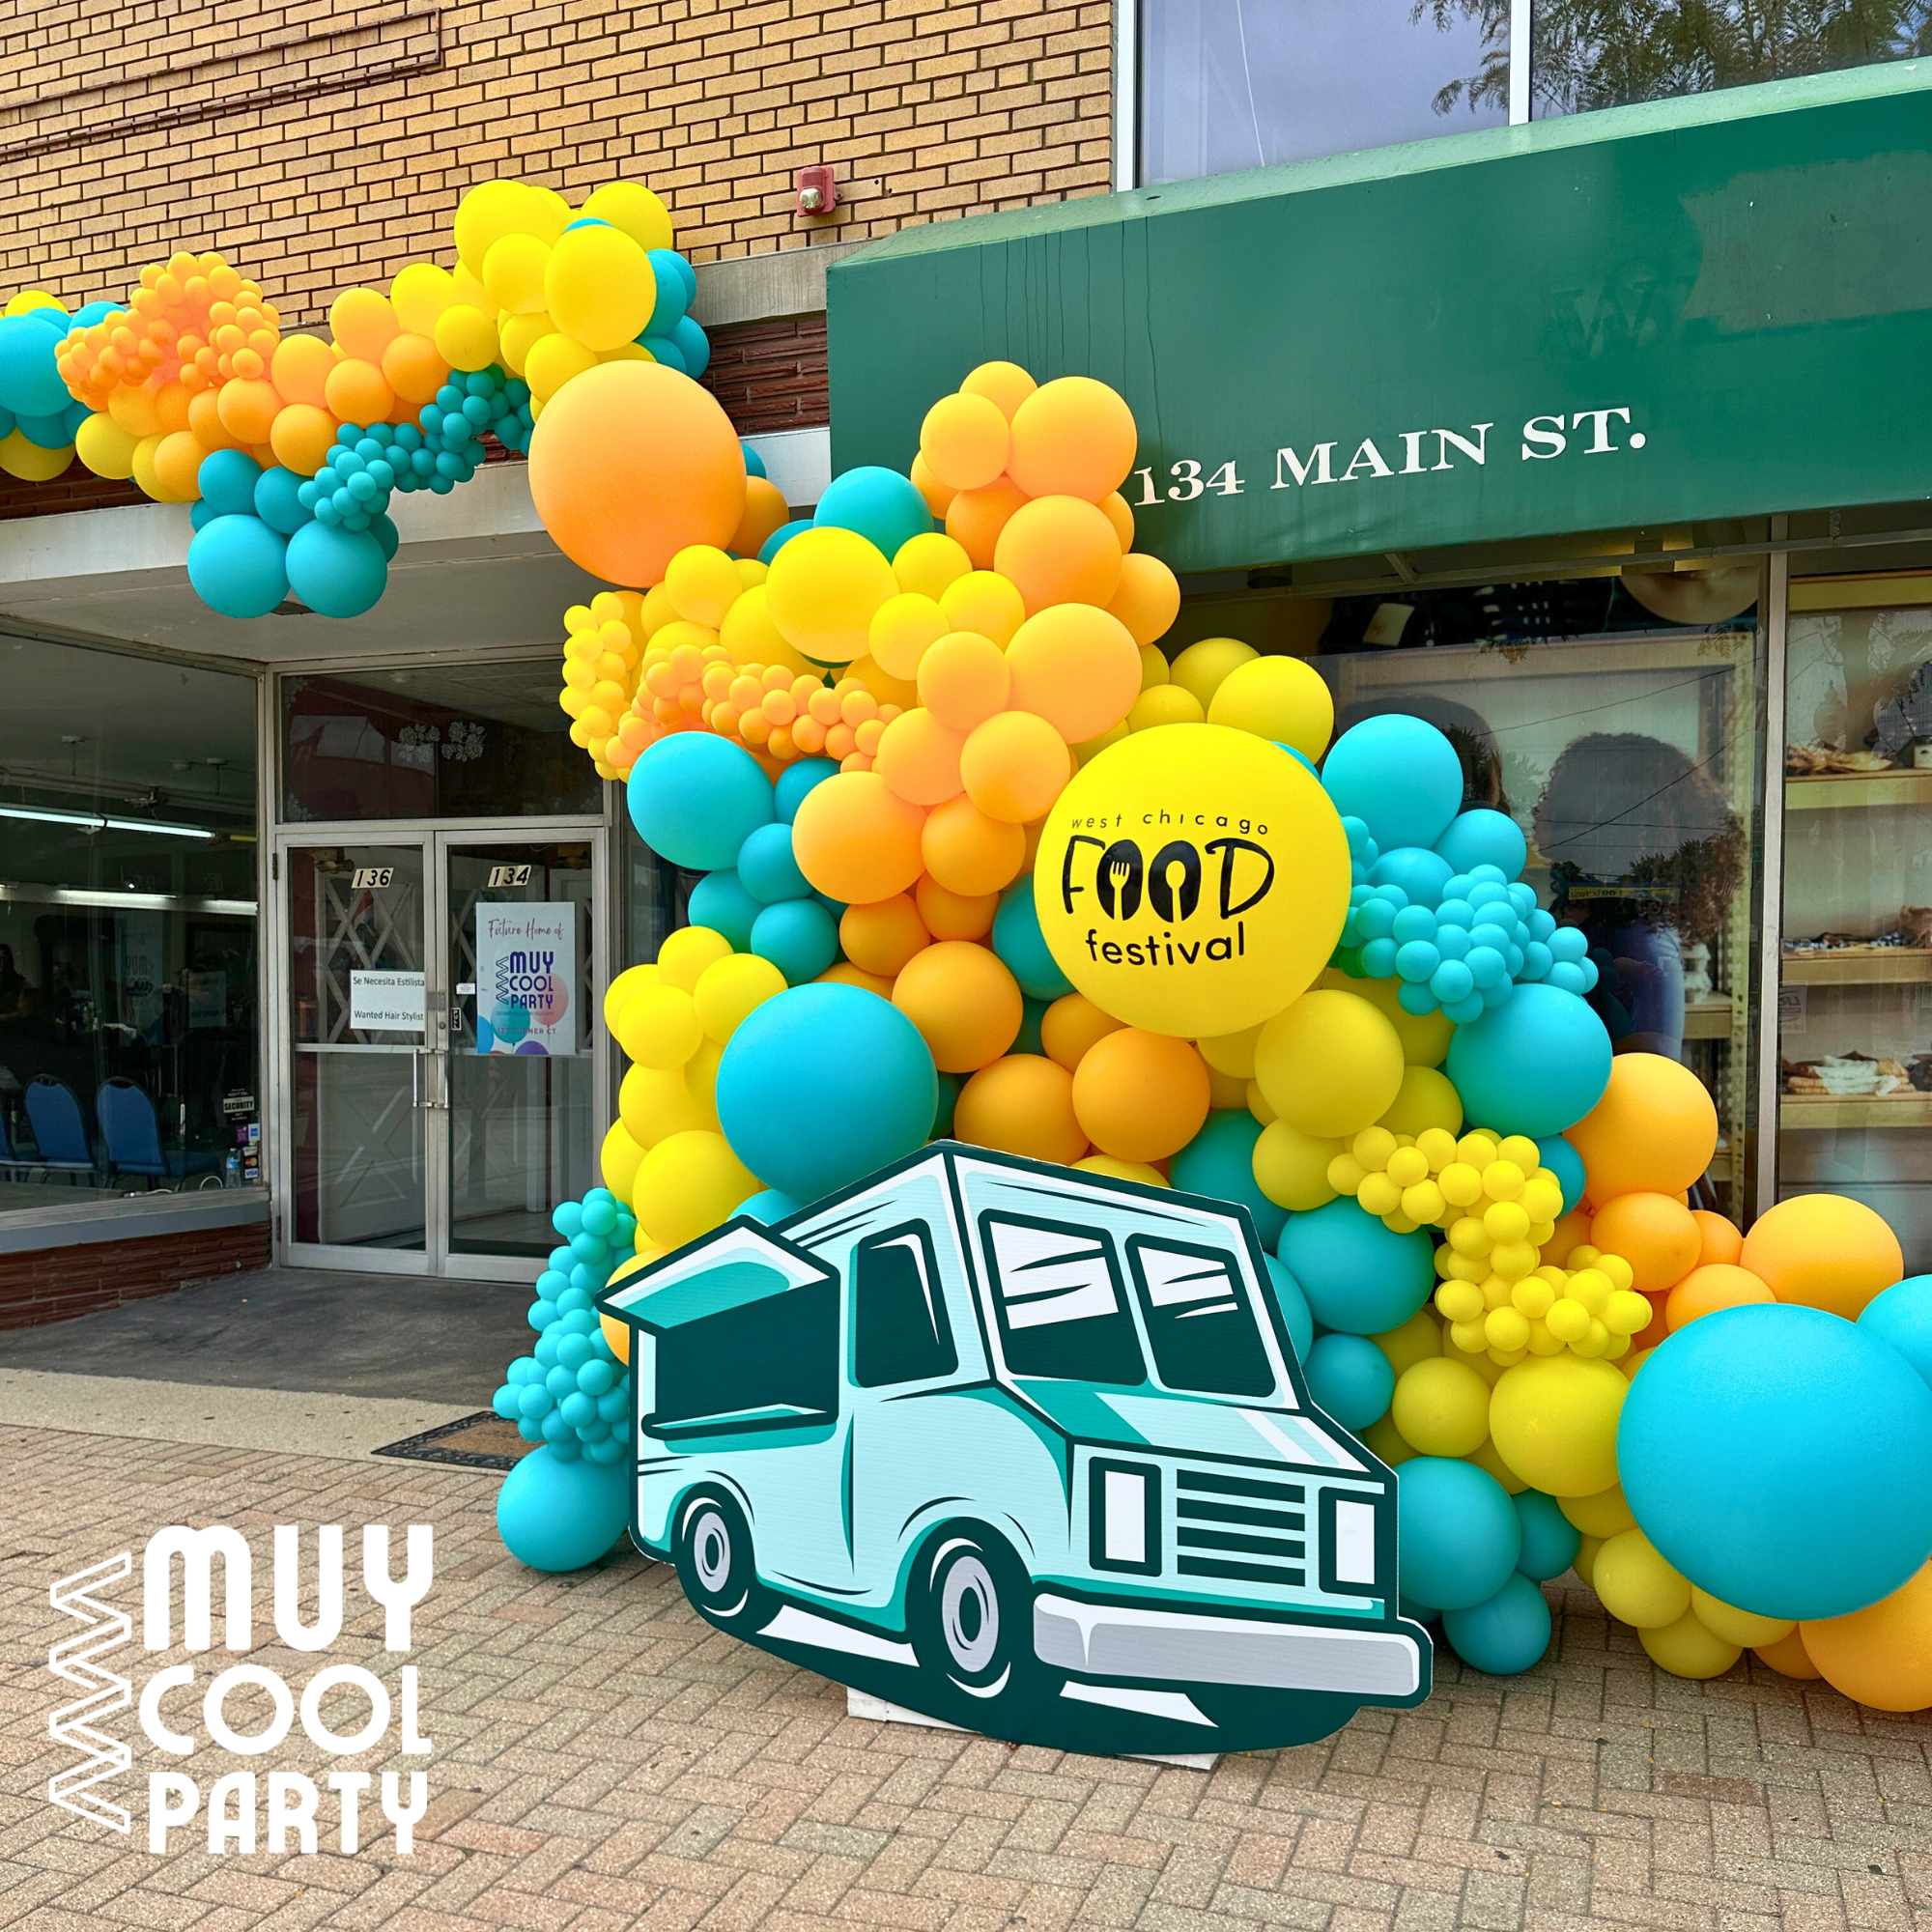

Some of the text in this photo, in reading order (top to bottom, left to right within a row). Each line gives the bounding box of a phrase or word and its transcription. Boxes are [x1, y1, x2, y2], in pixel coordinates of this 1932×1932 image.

[1133, 406, 1648, 508] 134 MAIN ST.
[1071, 809, 1268, 835] west chicago
[356, 868, 391, 887] 136
[493, 867, 530, 886] 134
[1062, 835, 1275, 923] FOOD
[487, 918, 565, 941] Future Home of
[1085, 921, 1245, 966] festival
[509, 951, 554, 975] MUY
[353, 977, 425, 986] Se Necesita Estilista
[509, 975, 554, 992] COOL
[510, 994, 554, 1009] PARTY
[354, 1010, 424, 1022] Wanted Hair Stylist
[224, 1101, 253, 1111] SECURITY
